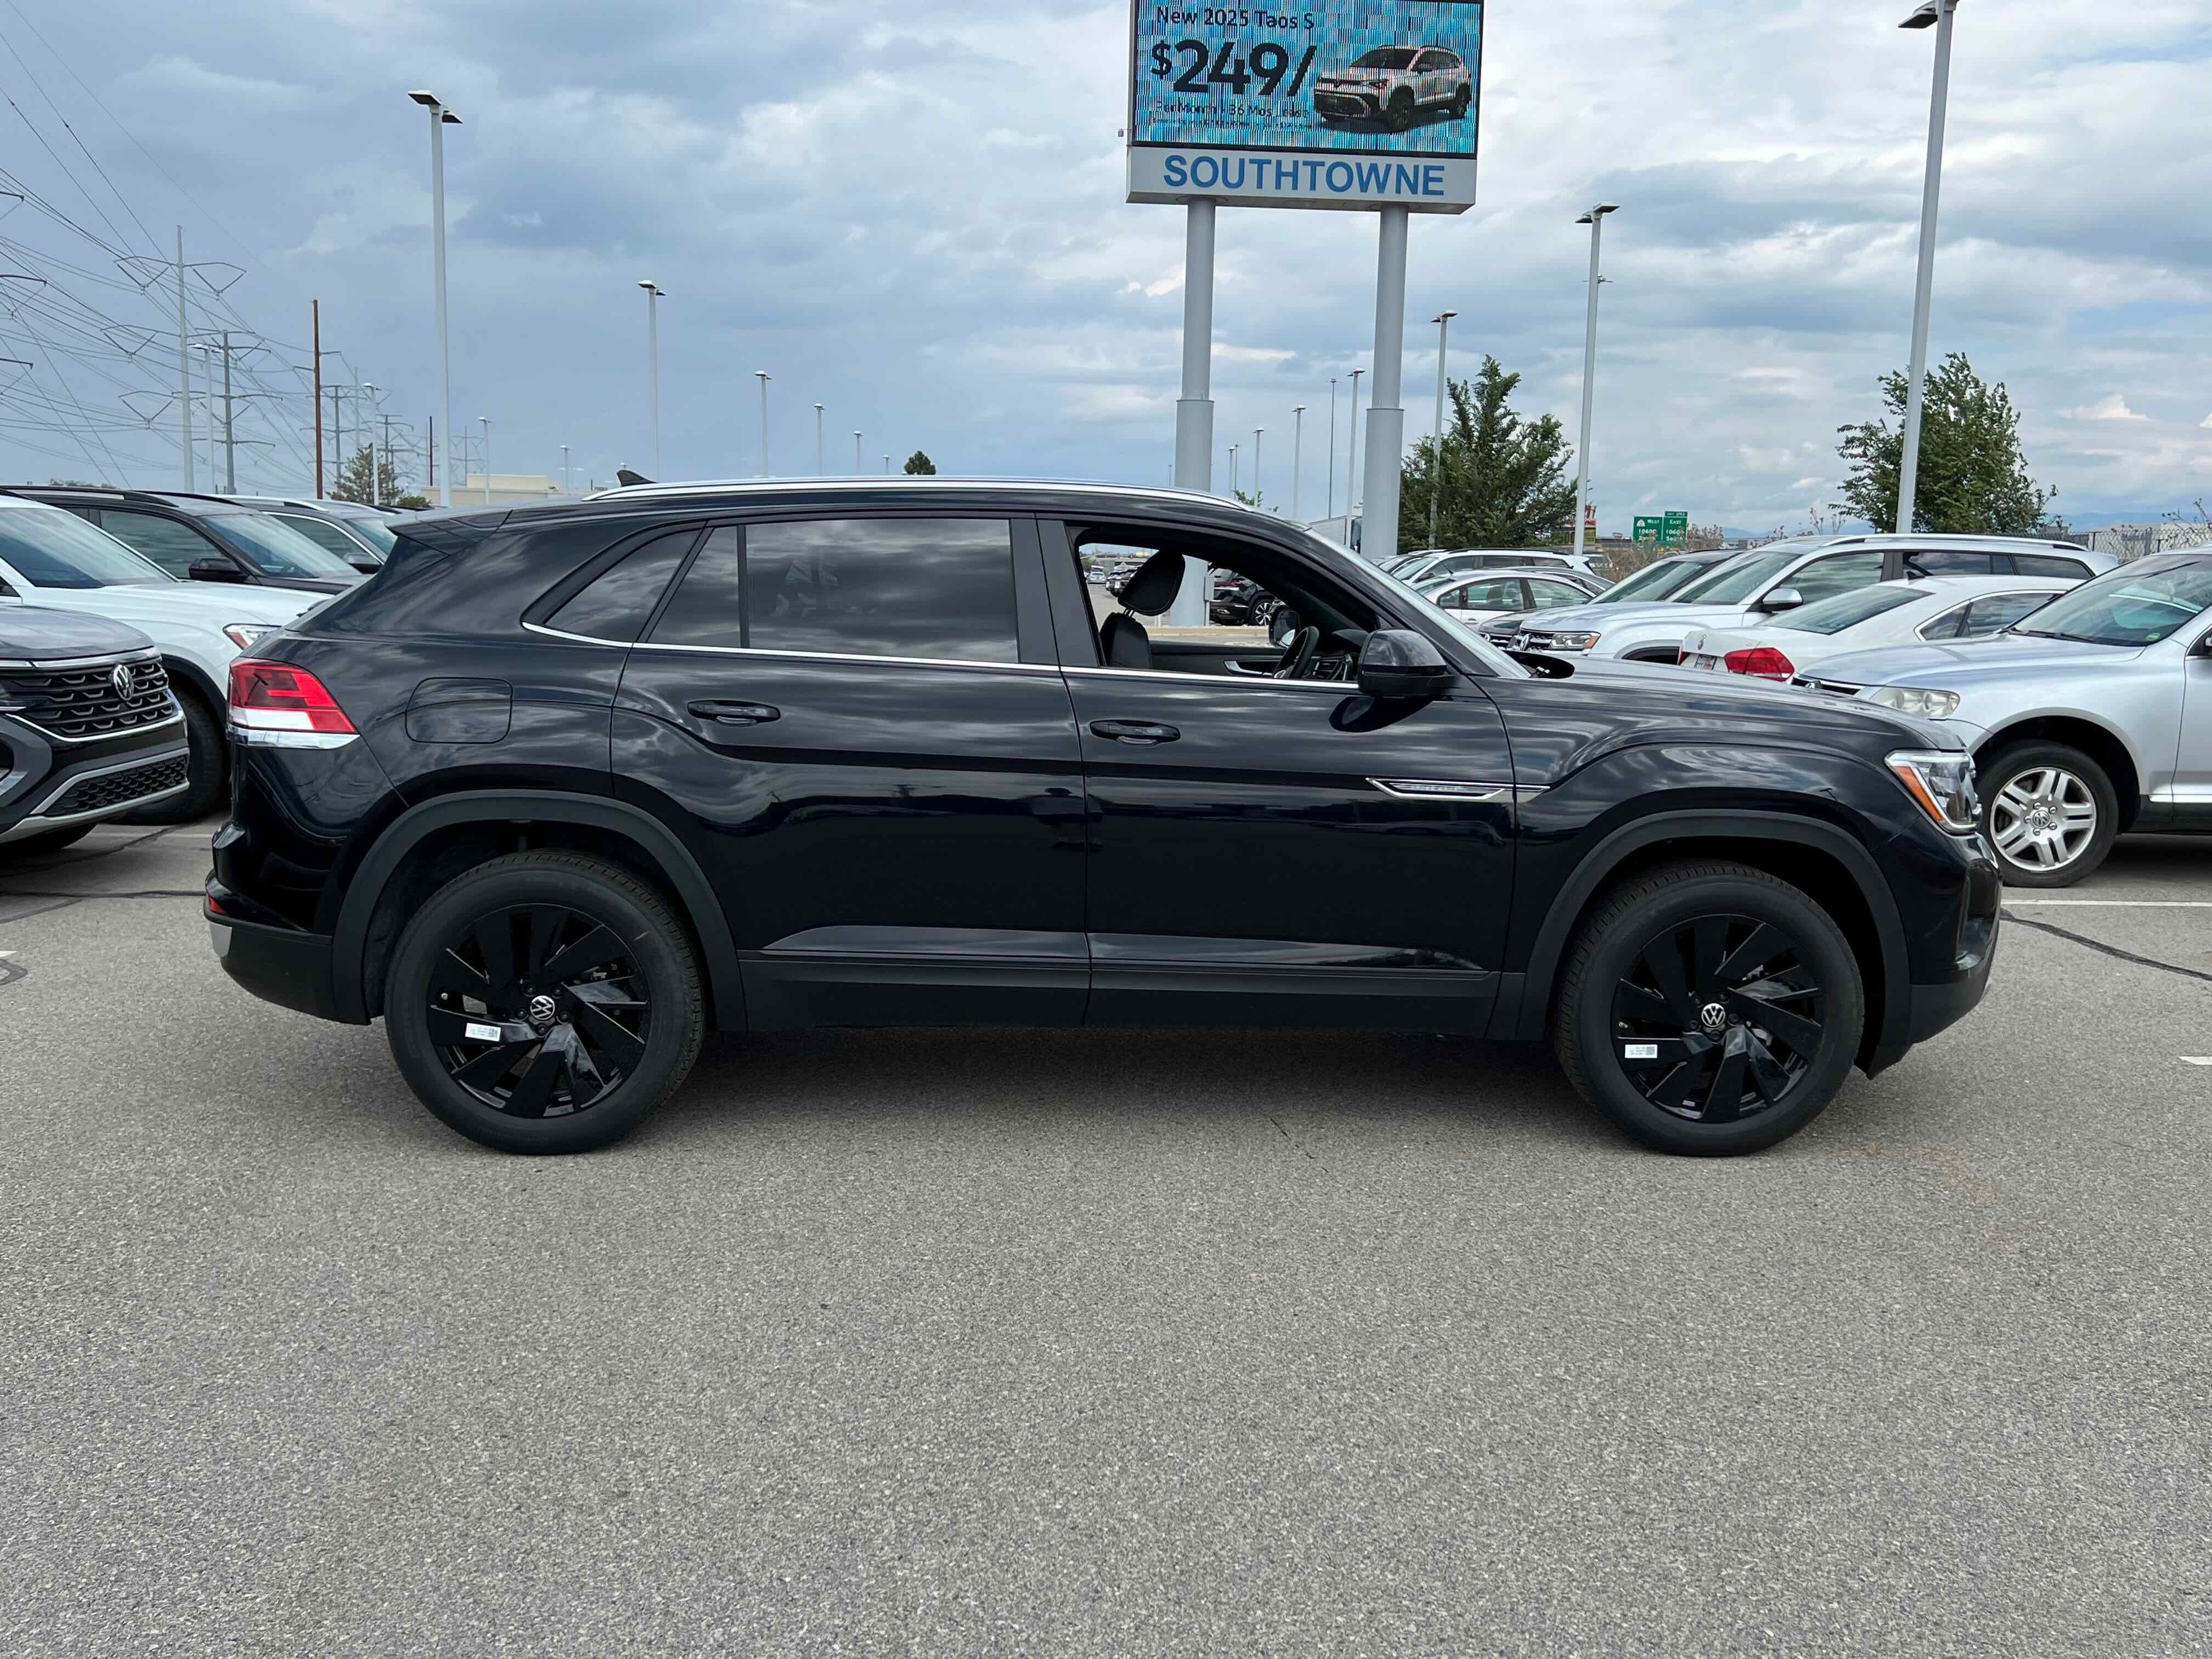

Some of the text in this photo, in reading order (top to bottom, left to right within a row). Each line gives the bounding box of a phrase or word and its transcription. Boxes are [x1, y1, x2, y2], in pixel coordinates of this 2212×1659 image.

[1157, 7, 1314, 29] New 2025 Taos S
[1229, 104, 1245, 116] 36
[1163, 154, 1445, 196] SOUTHTOWNE
